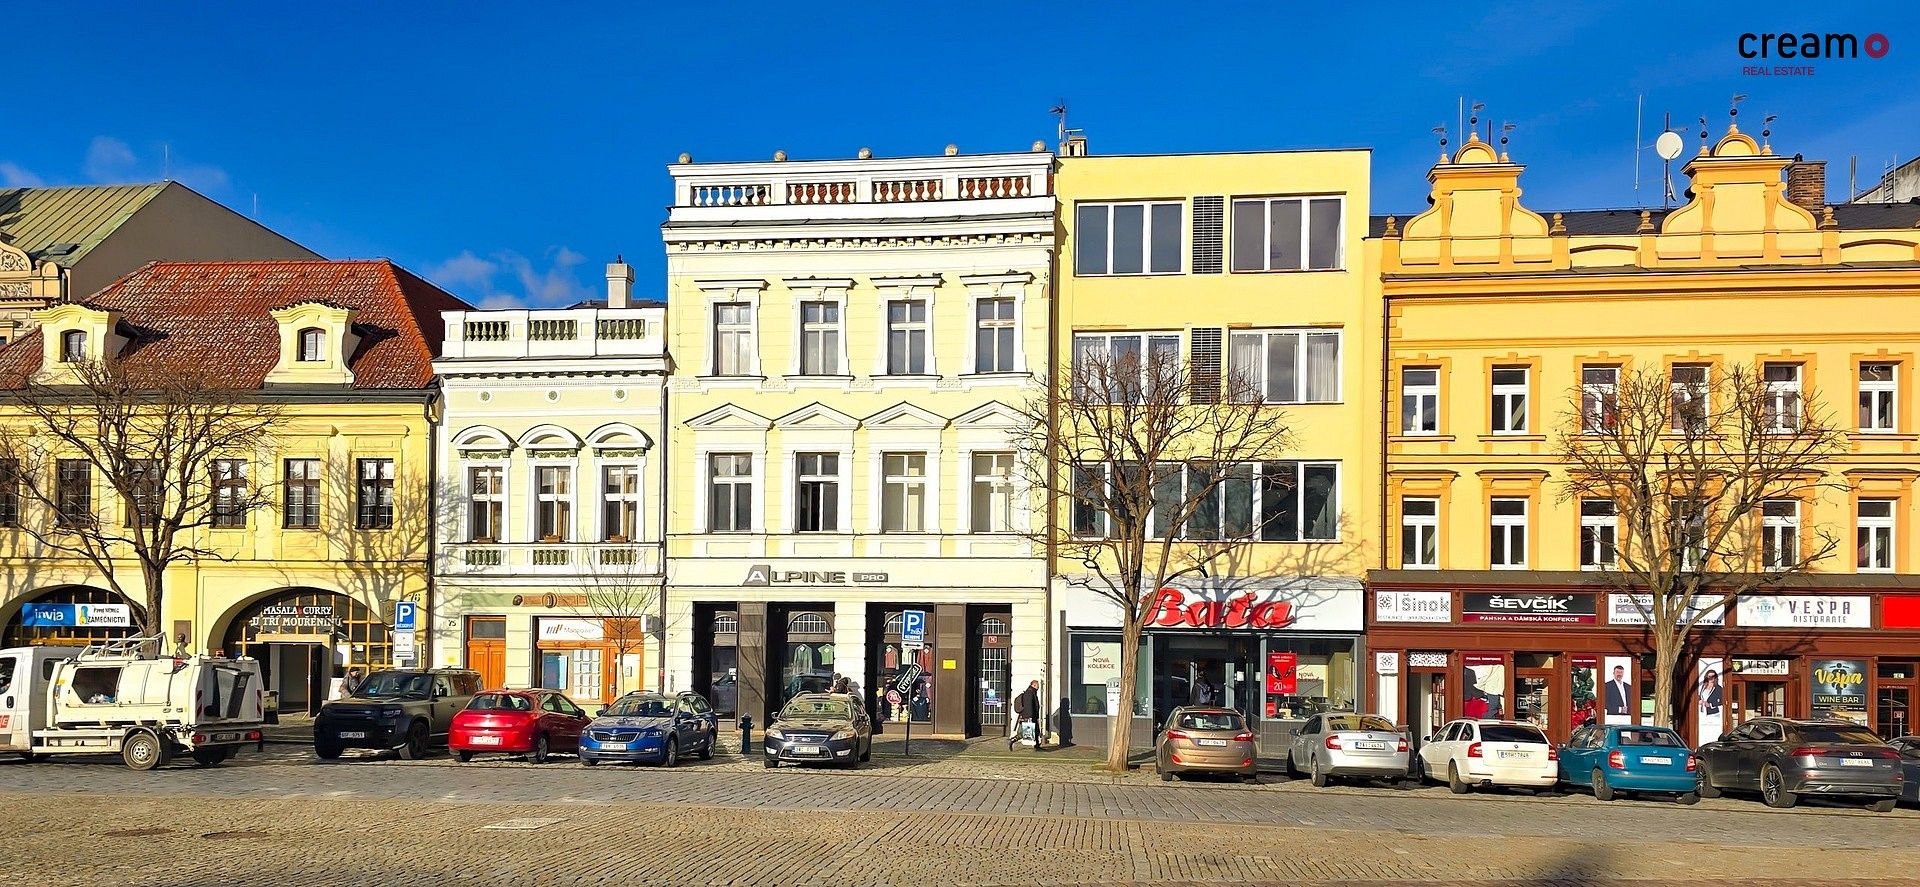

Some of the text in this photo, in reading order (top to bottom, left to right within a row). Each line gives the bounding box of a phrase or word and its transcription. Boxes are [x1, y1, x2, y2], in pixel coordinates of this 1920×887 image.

[742, 565, 846, 586] ALPINE
[1401, 593, 1450, 612] Šinok
[1489, 595, 1568, 610] ŠEVČÍK
[1789, 600, 1851, 615] VESPA
[34, 608, 64, 622] invia
[262, 606, 332, 615] MASALA CURRY
[399, 605, 412, 623] P
[907, 614, 920, 632] P
[1793, 615, 1847, 623] RISTORANTE
[1747, 660, 1786, 669] VESPA
[1814, 668, 1864, 688] Vespa
